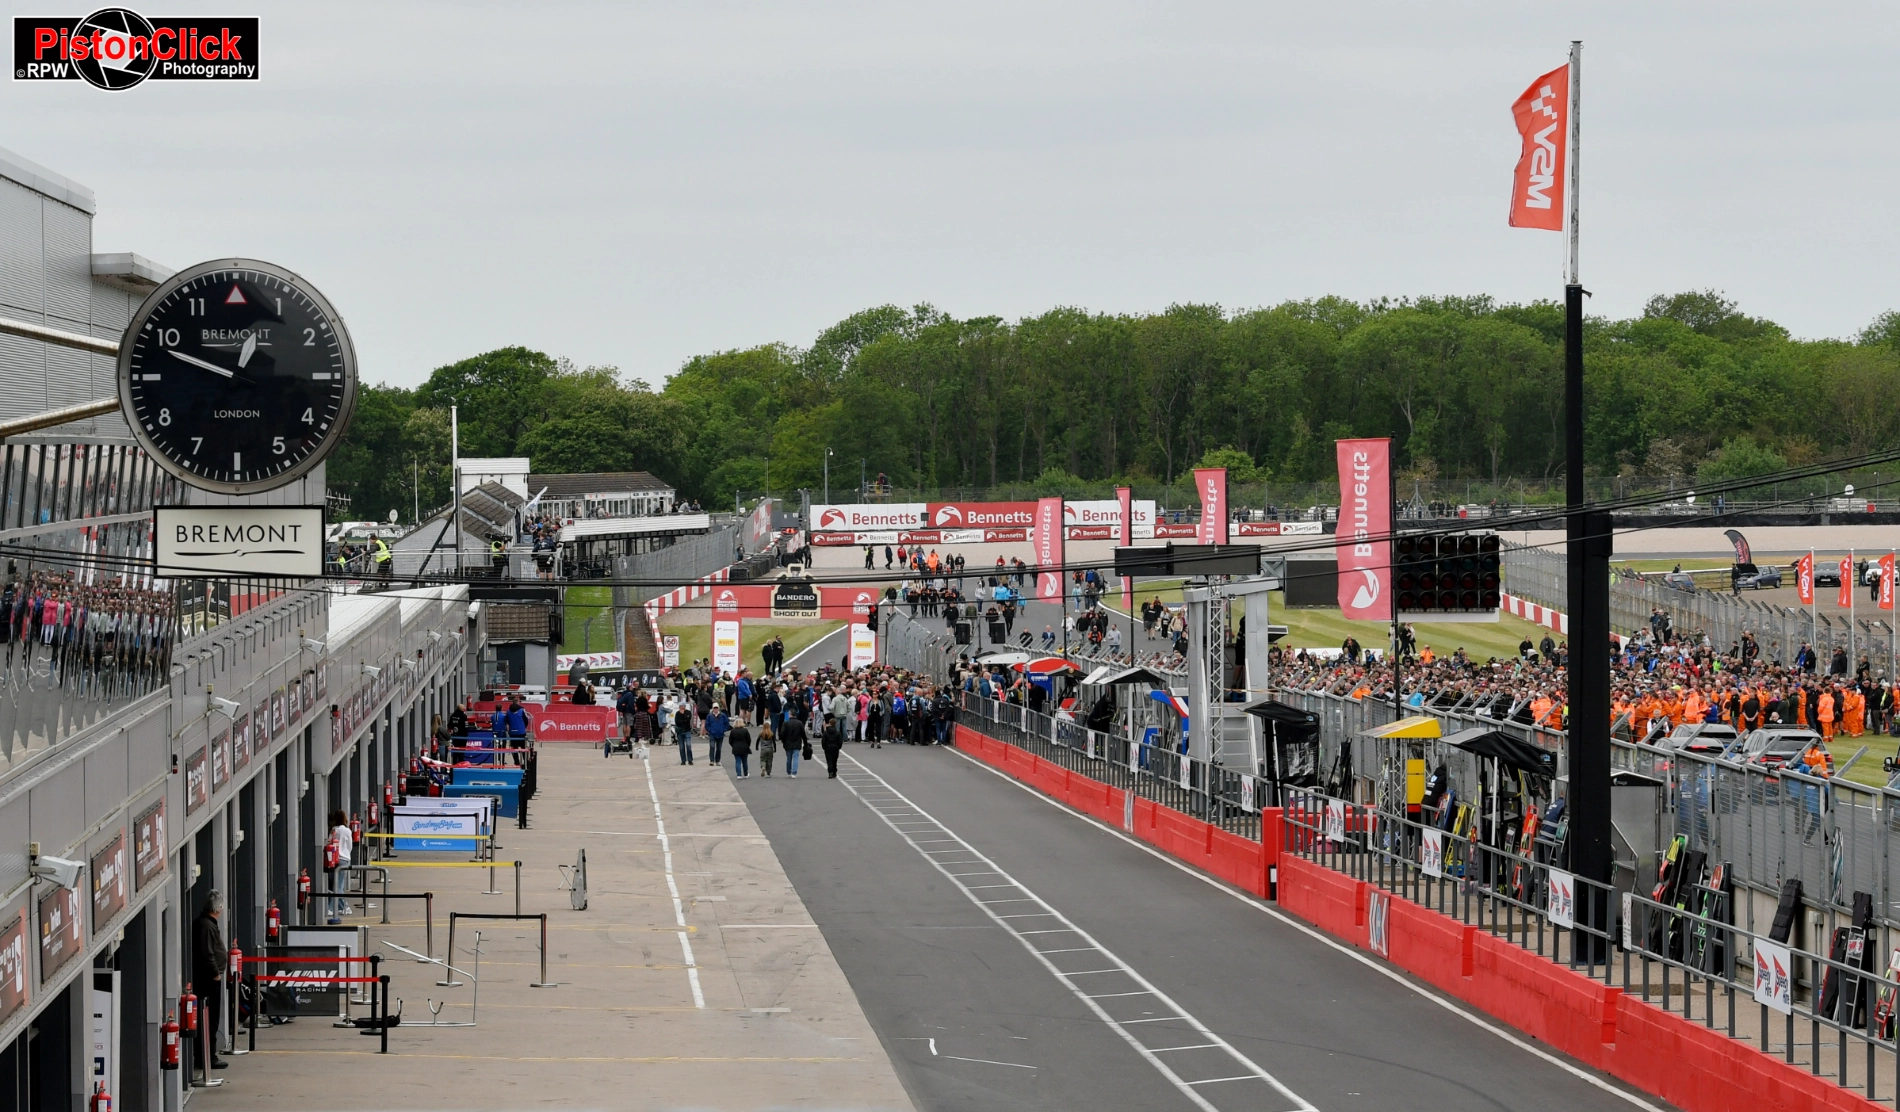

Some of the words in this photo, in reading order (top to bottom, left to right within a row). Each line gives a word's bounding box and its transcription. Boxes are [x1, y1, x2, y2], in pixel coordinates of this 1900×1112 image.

[189, 298, 205, 316] 11
[275, 298, 282, 316] 1
[156, 328, 180, 347] 10
[303, 328, 316, 346] 2
[158, 407, 172, 427] 8
[214, 409, 260, 418] LONDON
[301, 407, 314, 426] 4
[190, 437, 204, 455] 7
[272, 437, 286, 455] 5
[852, 513, 917, 525] Bennetts
[968, 511, 1032, 524] Bennetts
[176, 524, 302, 542] BREMONT
[560, 722, 600, 731] Bennetts
